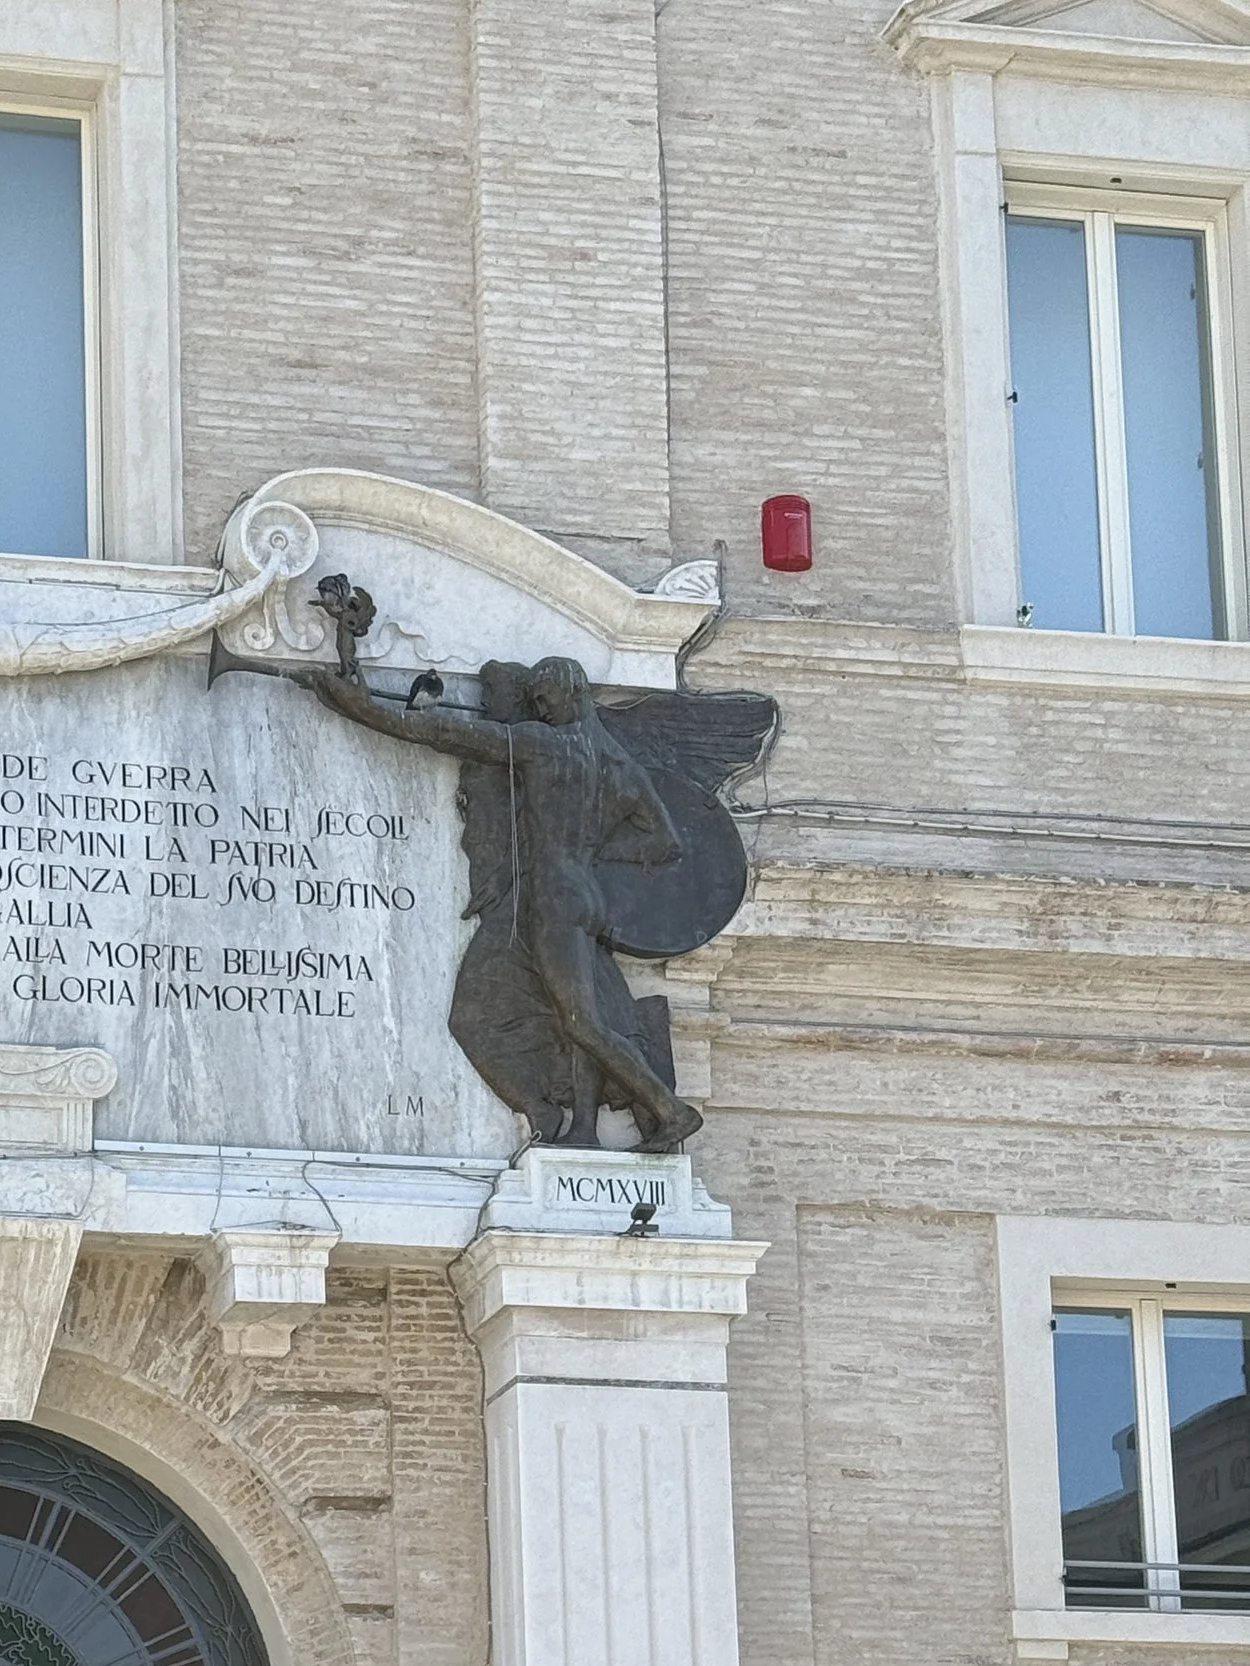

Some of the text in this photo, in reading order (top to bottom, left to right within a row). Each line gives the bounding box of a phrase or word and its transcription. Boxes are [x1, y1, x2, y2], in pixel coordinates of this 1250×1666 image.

[72, 759, 217, 793] GVERRA
[37, 792, 219, 828] INTERDETTO
[241, 806, 291, 832] NEI
[145, 835, 189, 863] LA
[209, 840, 319, 870] PATRIA
[150, 872, 210, 900] DEL
[220, 872, 276, 906] SVO
[295, 878, 415, 911] DESTINO
[2, 935, 67, 965] ALLA
[86, 940, 204, 972] MORTE
[13, 974, 135, 1008] GLORIA
[154, 982, 356, 1018] IMMORTALE
[556, 1175, 666, 1207] MCMXVIII
